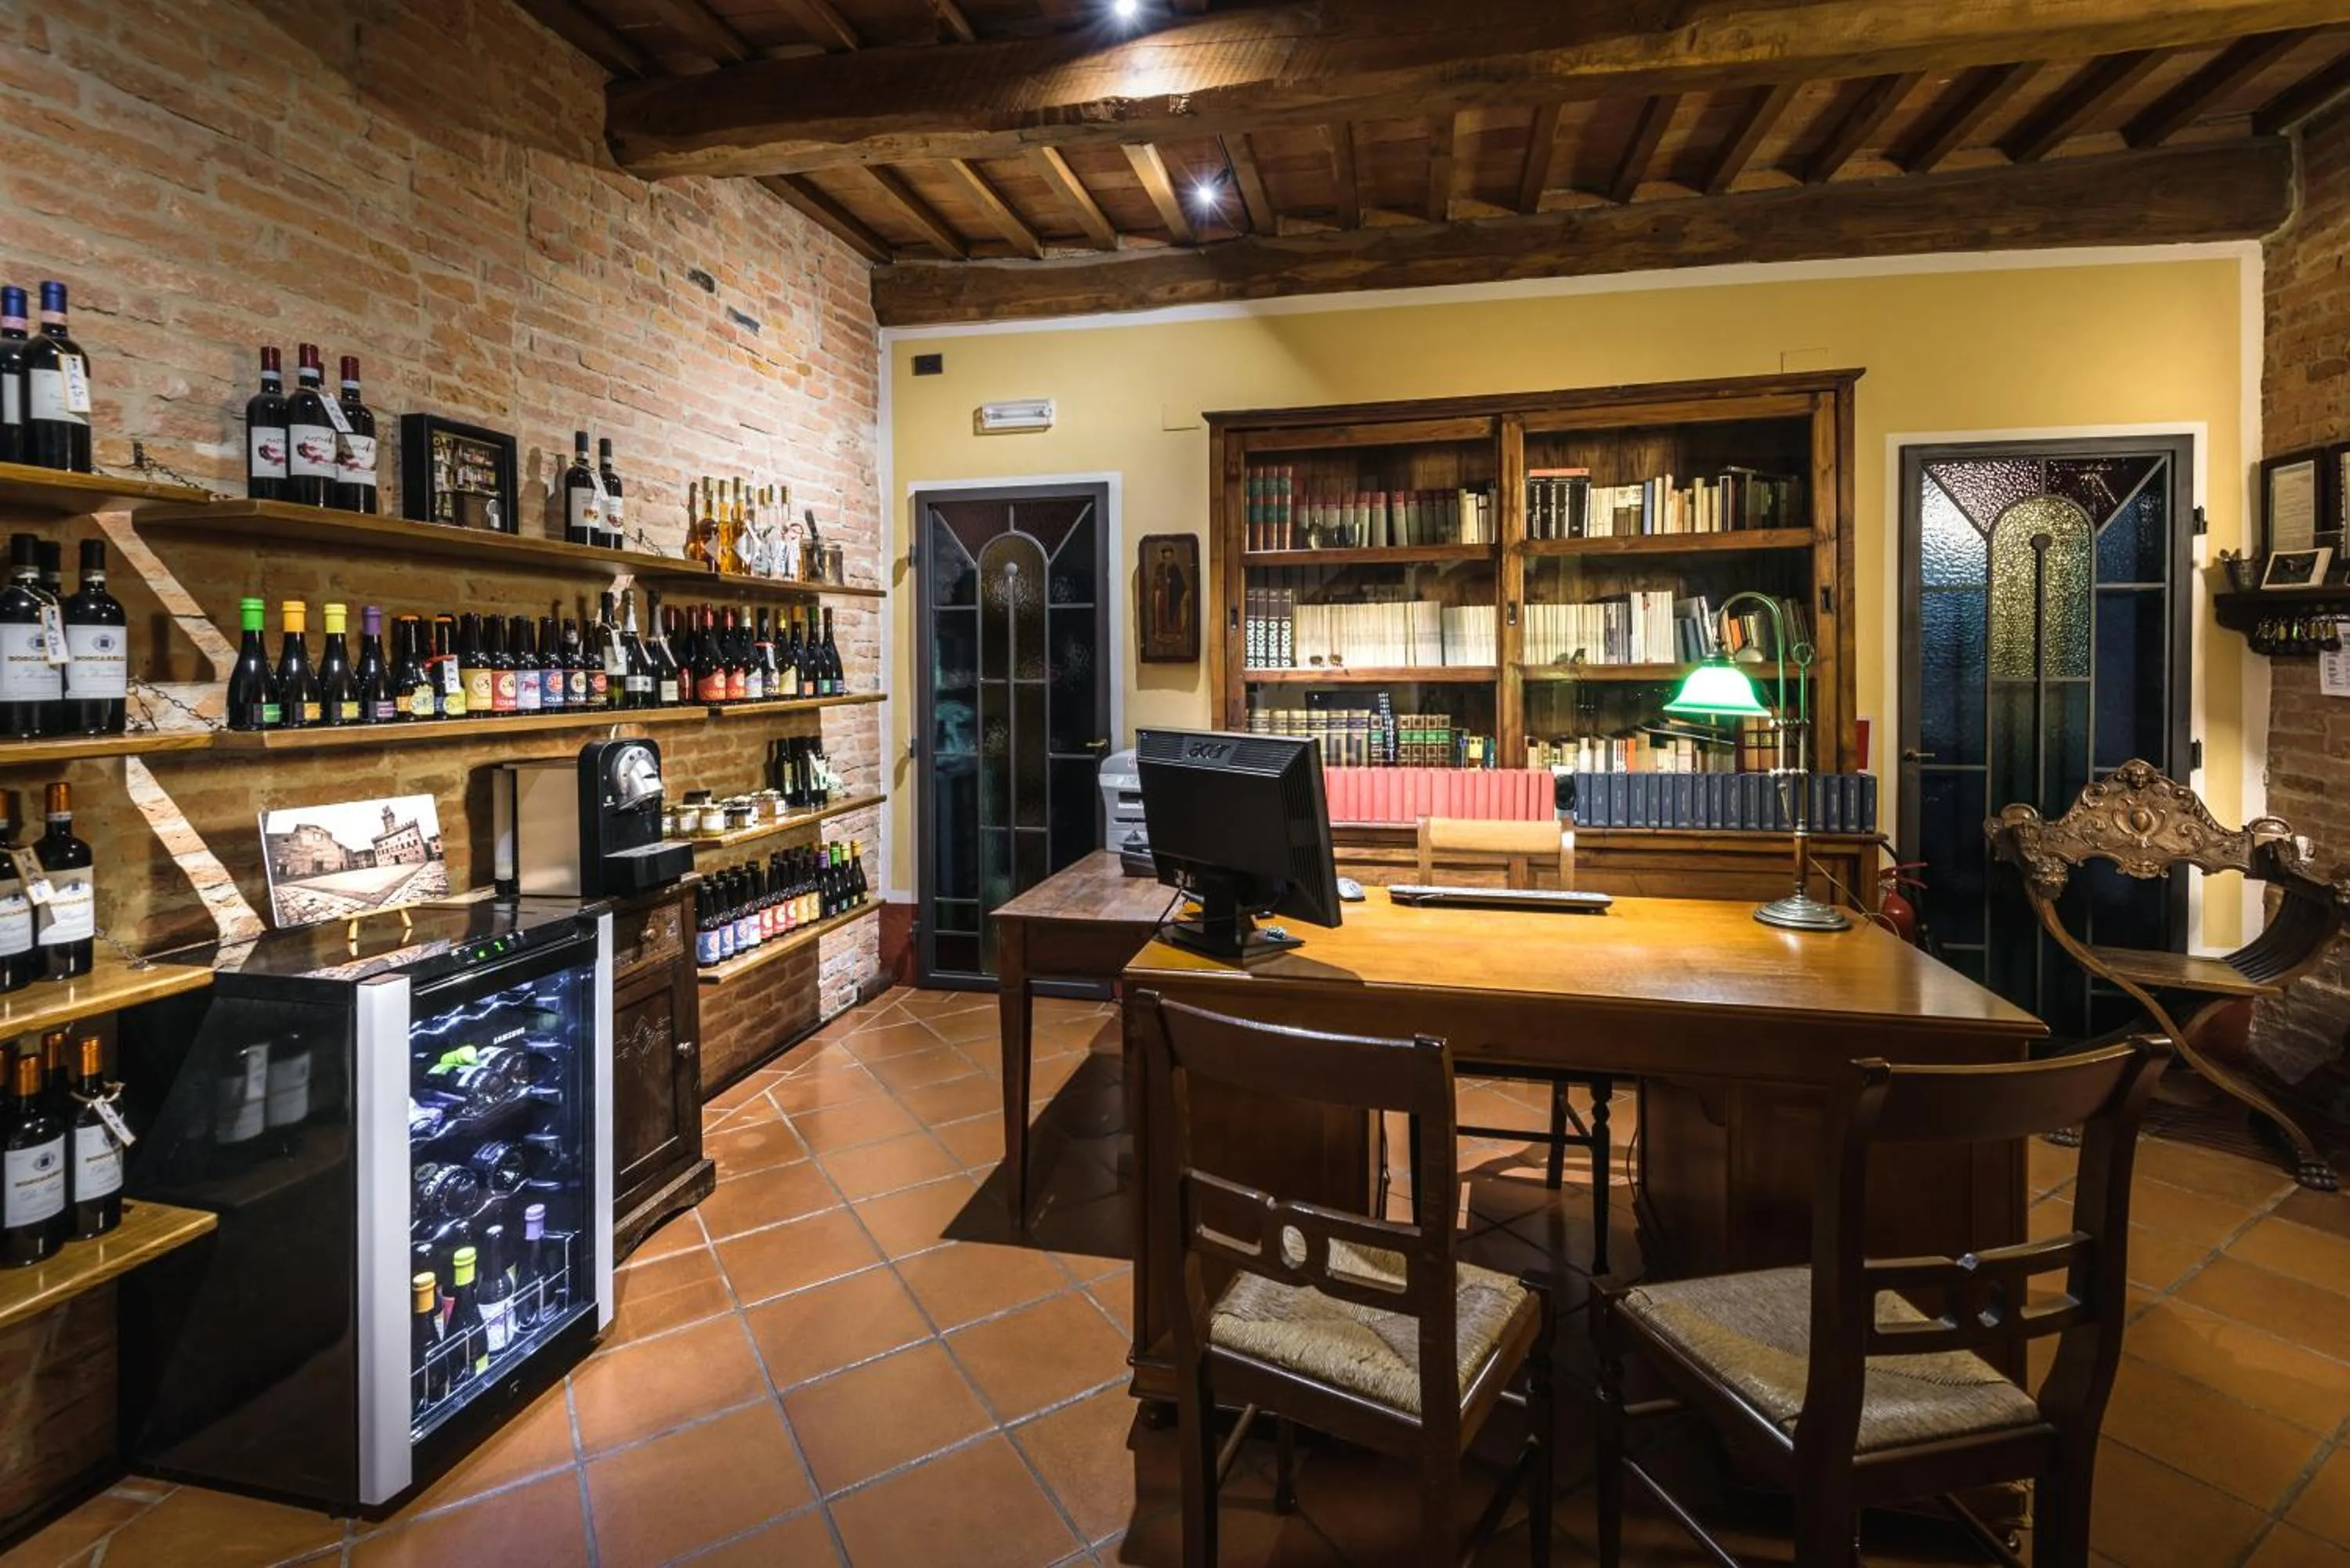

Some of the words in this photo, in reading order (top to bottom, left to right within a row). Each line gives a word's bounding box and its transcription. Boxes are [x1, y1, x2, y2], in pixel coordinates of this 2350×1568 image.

[1256, 620, 1266, 657] SECOLO
[1269, 621, 1278, 658] SECOLO
[1282, 620, 1291, 658] SECOLO
[1187, 742, 1231, 759] acer
[493, 1026, 526, 1045] SAMSUNG
